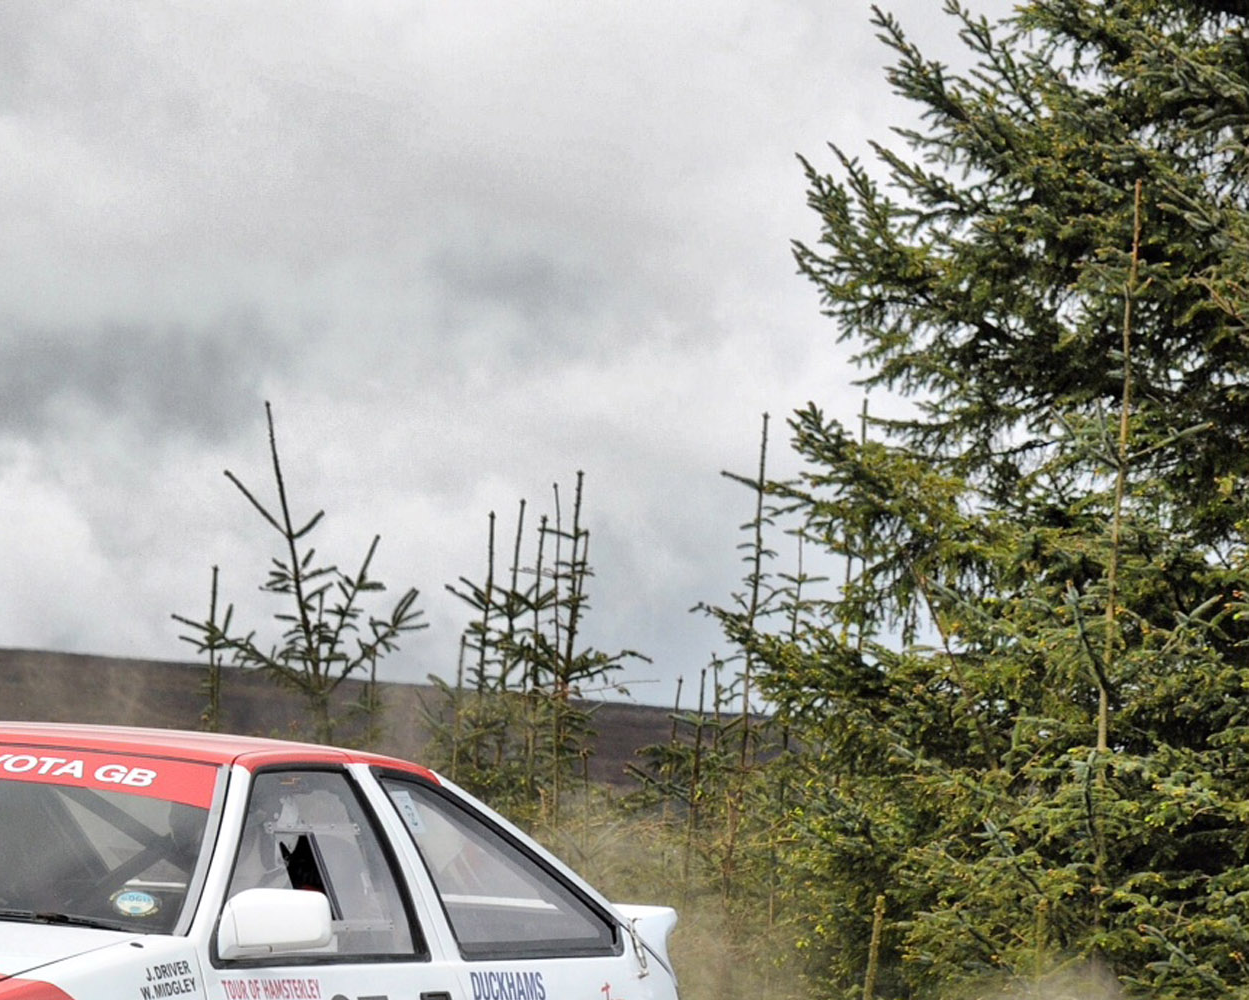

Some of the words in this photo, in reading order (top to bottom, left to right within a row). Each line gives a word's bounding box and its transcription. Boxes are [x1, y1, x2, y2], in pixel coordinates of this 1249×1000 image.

[94, 764, 157, 787] GB
[221, 979, 247, 1000] TOUR
[248, 979, 261, 1000] OF
[263, 978, 322, 1000] HAMSTERLEY
